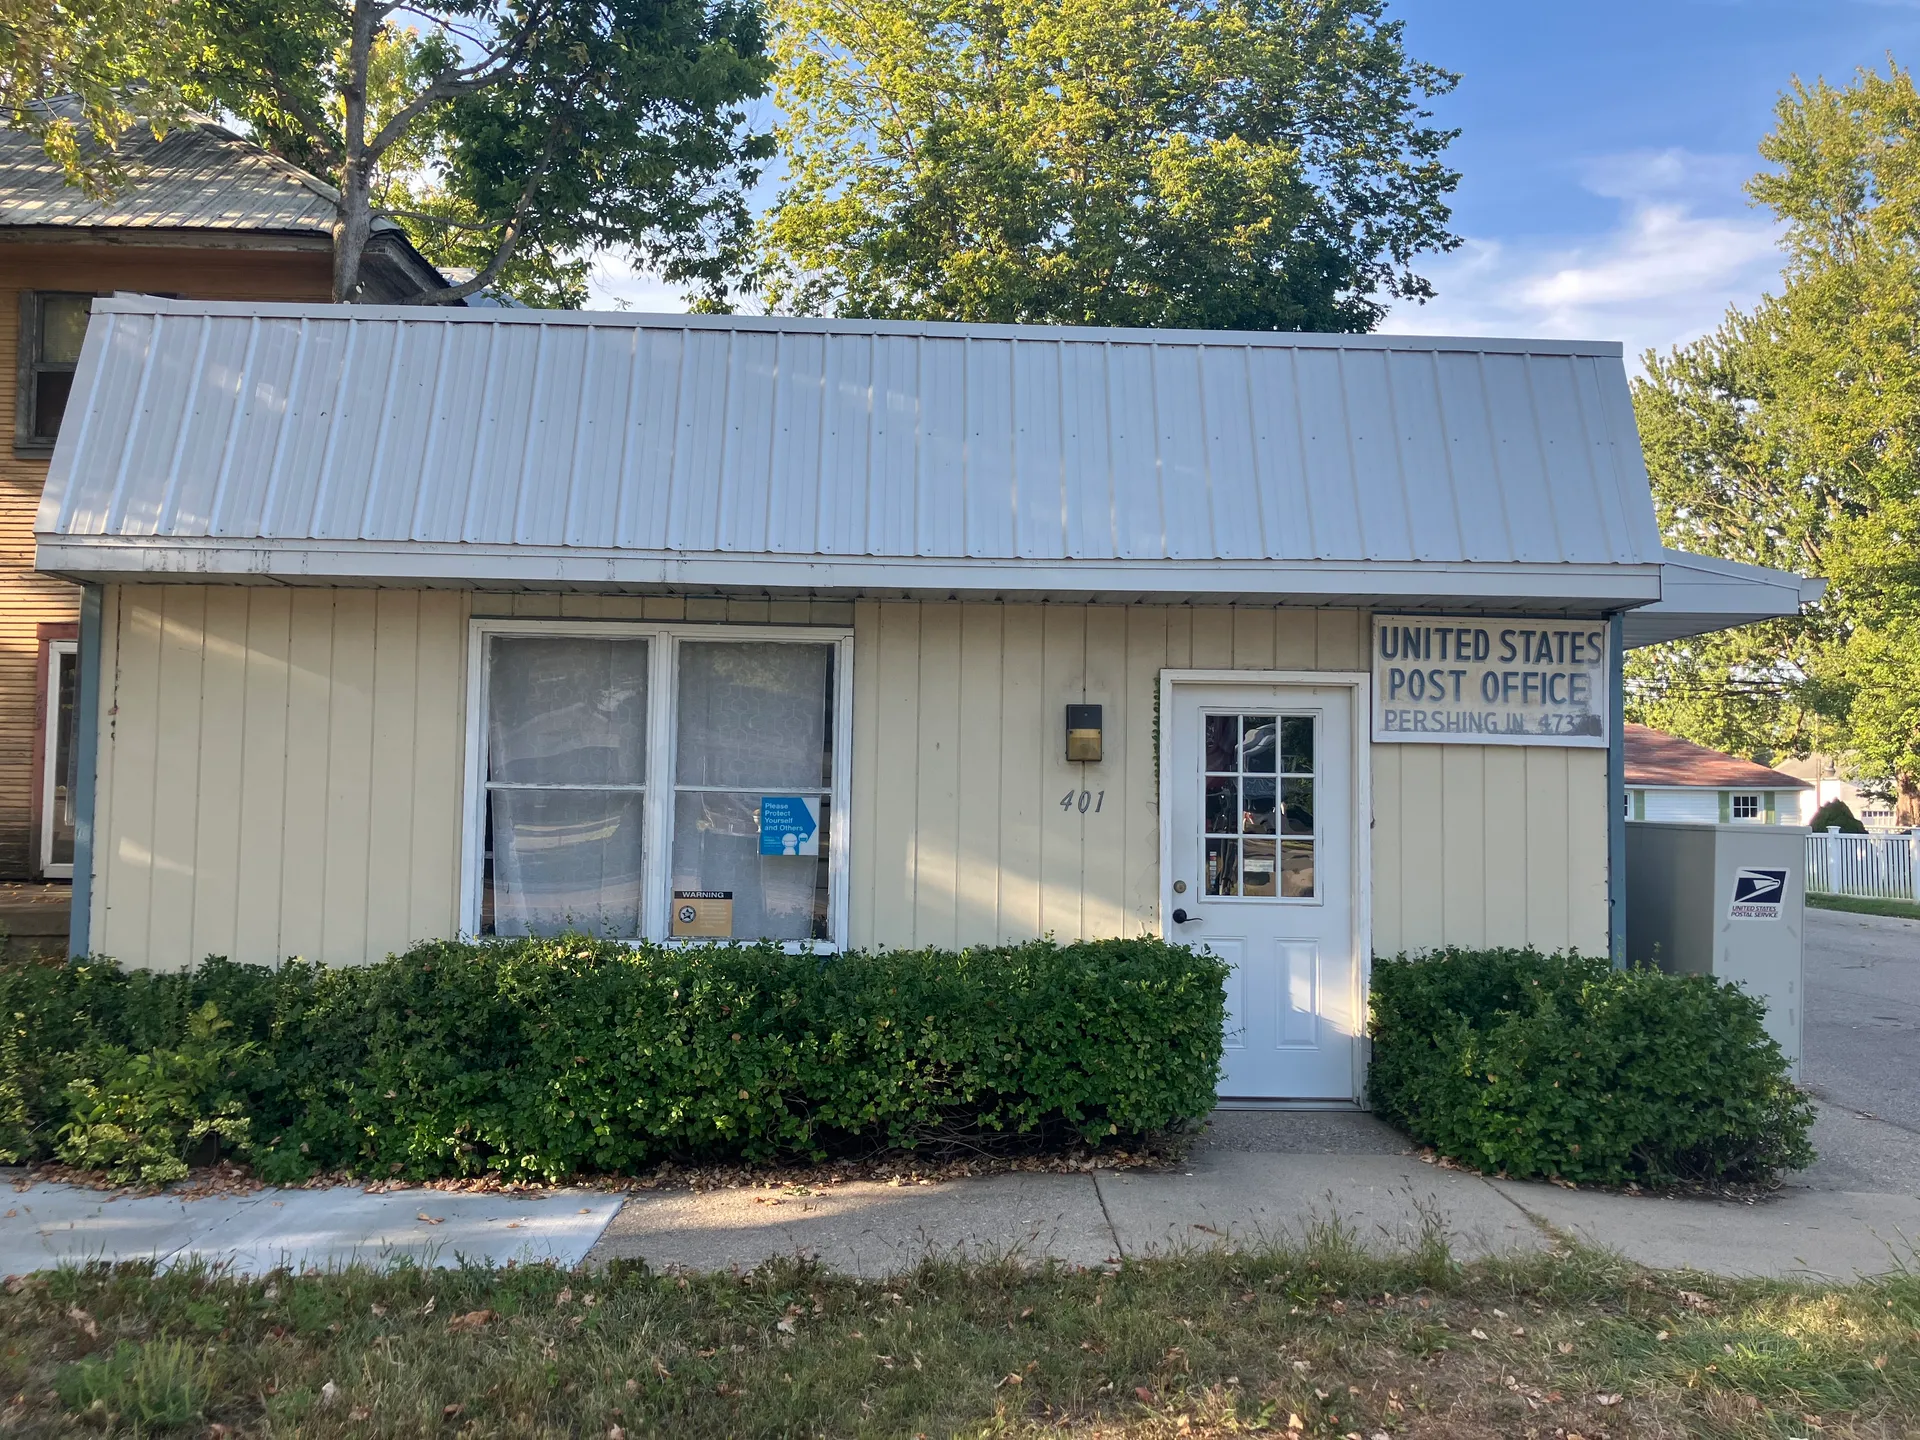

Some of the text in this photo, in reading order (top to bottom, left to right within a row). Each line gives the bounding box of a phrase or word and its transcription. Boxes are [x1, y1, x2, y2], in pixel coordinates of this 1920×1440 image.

[1380, 626, 1602, 665] UNITED STATES
[1389, 668, 1588, 705] POST OFFICE
[1060, 789, 1105, 813] 401
